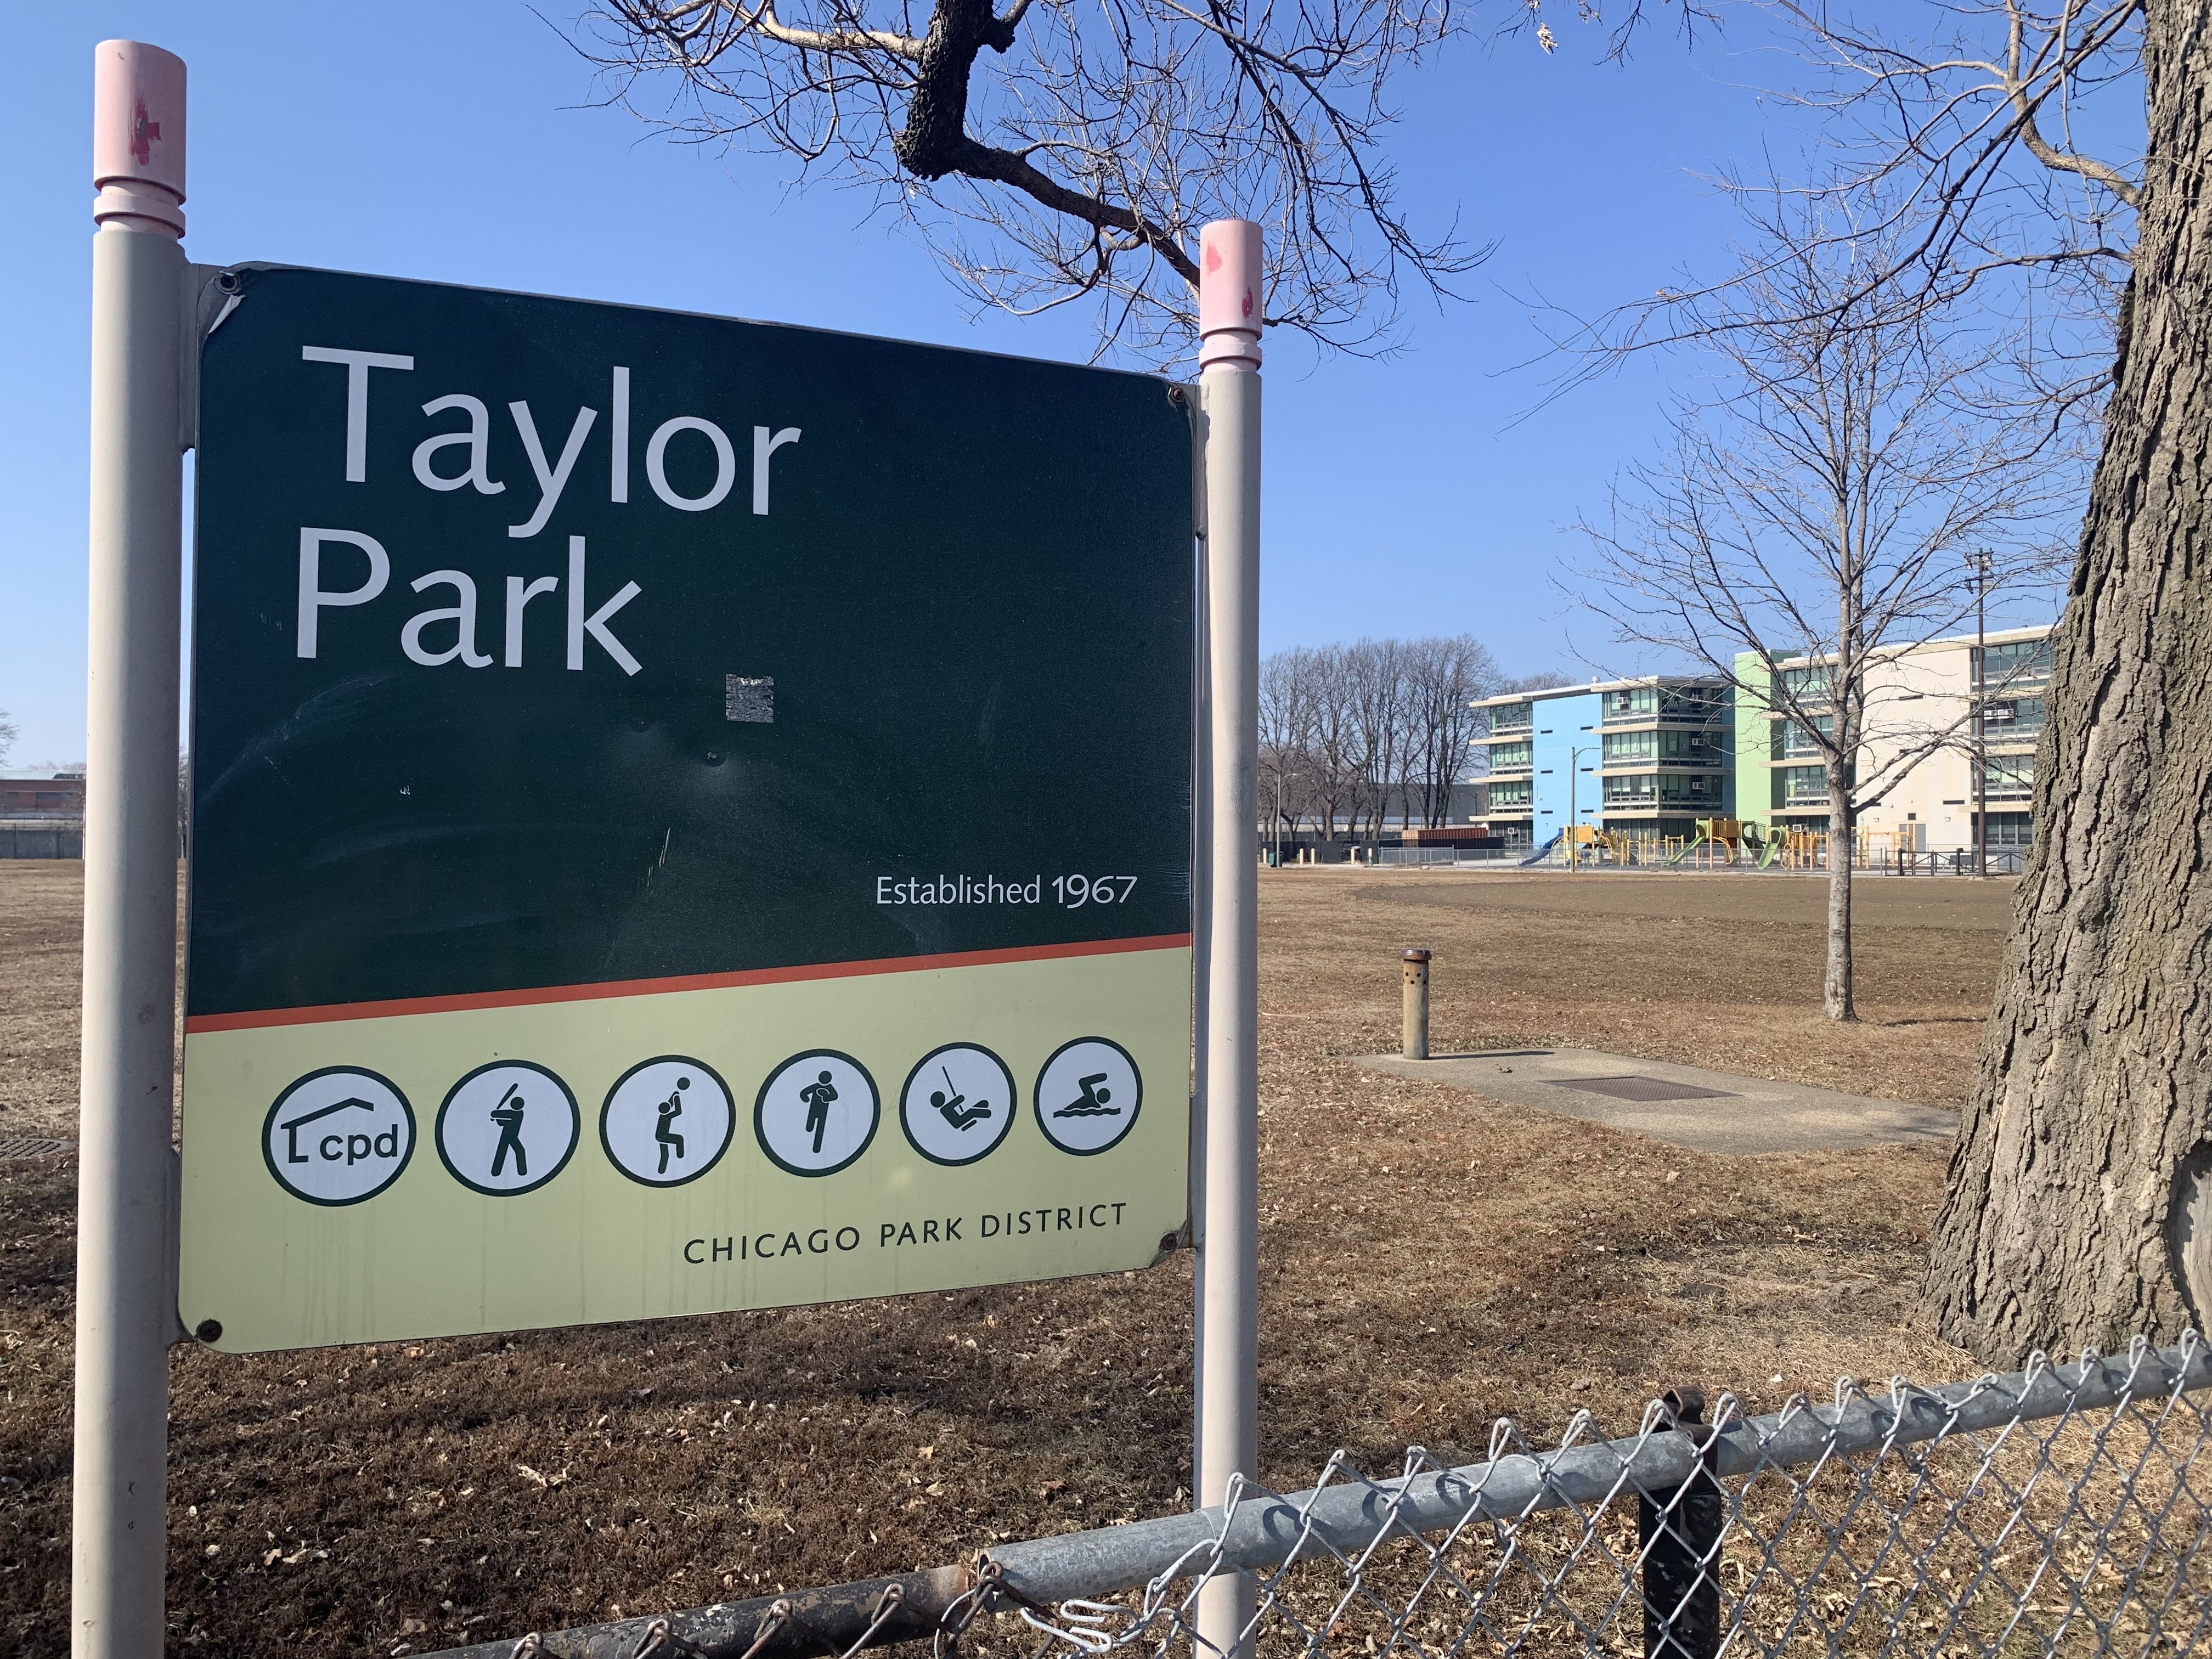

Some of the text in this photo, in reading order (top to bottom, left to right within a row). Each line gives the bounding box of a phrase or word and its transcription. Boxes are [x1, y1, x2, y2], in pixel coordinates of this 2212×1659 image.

[303, 346, 802, 538] Taylor
[297, 527, 642, 676] Park
[877, 874, 1138, 909] Established 1967
[319, 1124, 398, 1166] cpd
[684, 1202, 1126, 1264] CHICAGO PARK DISTRICT
